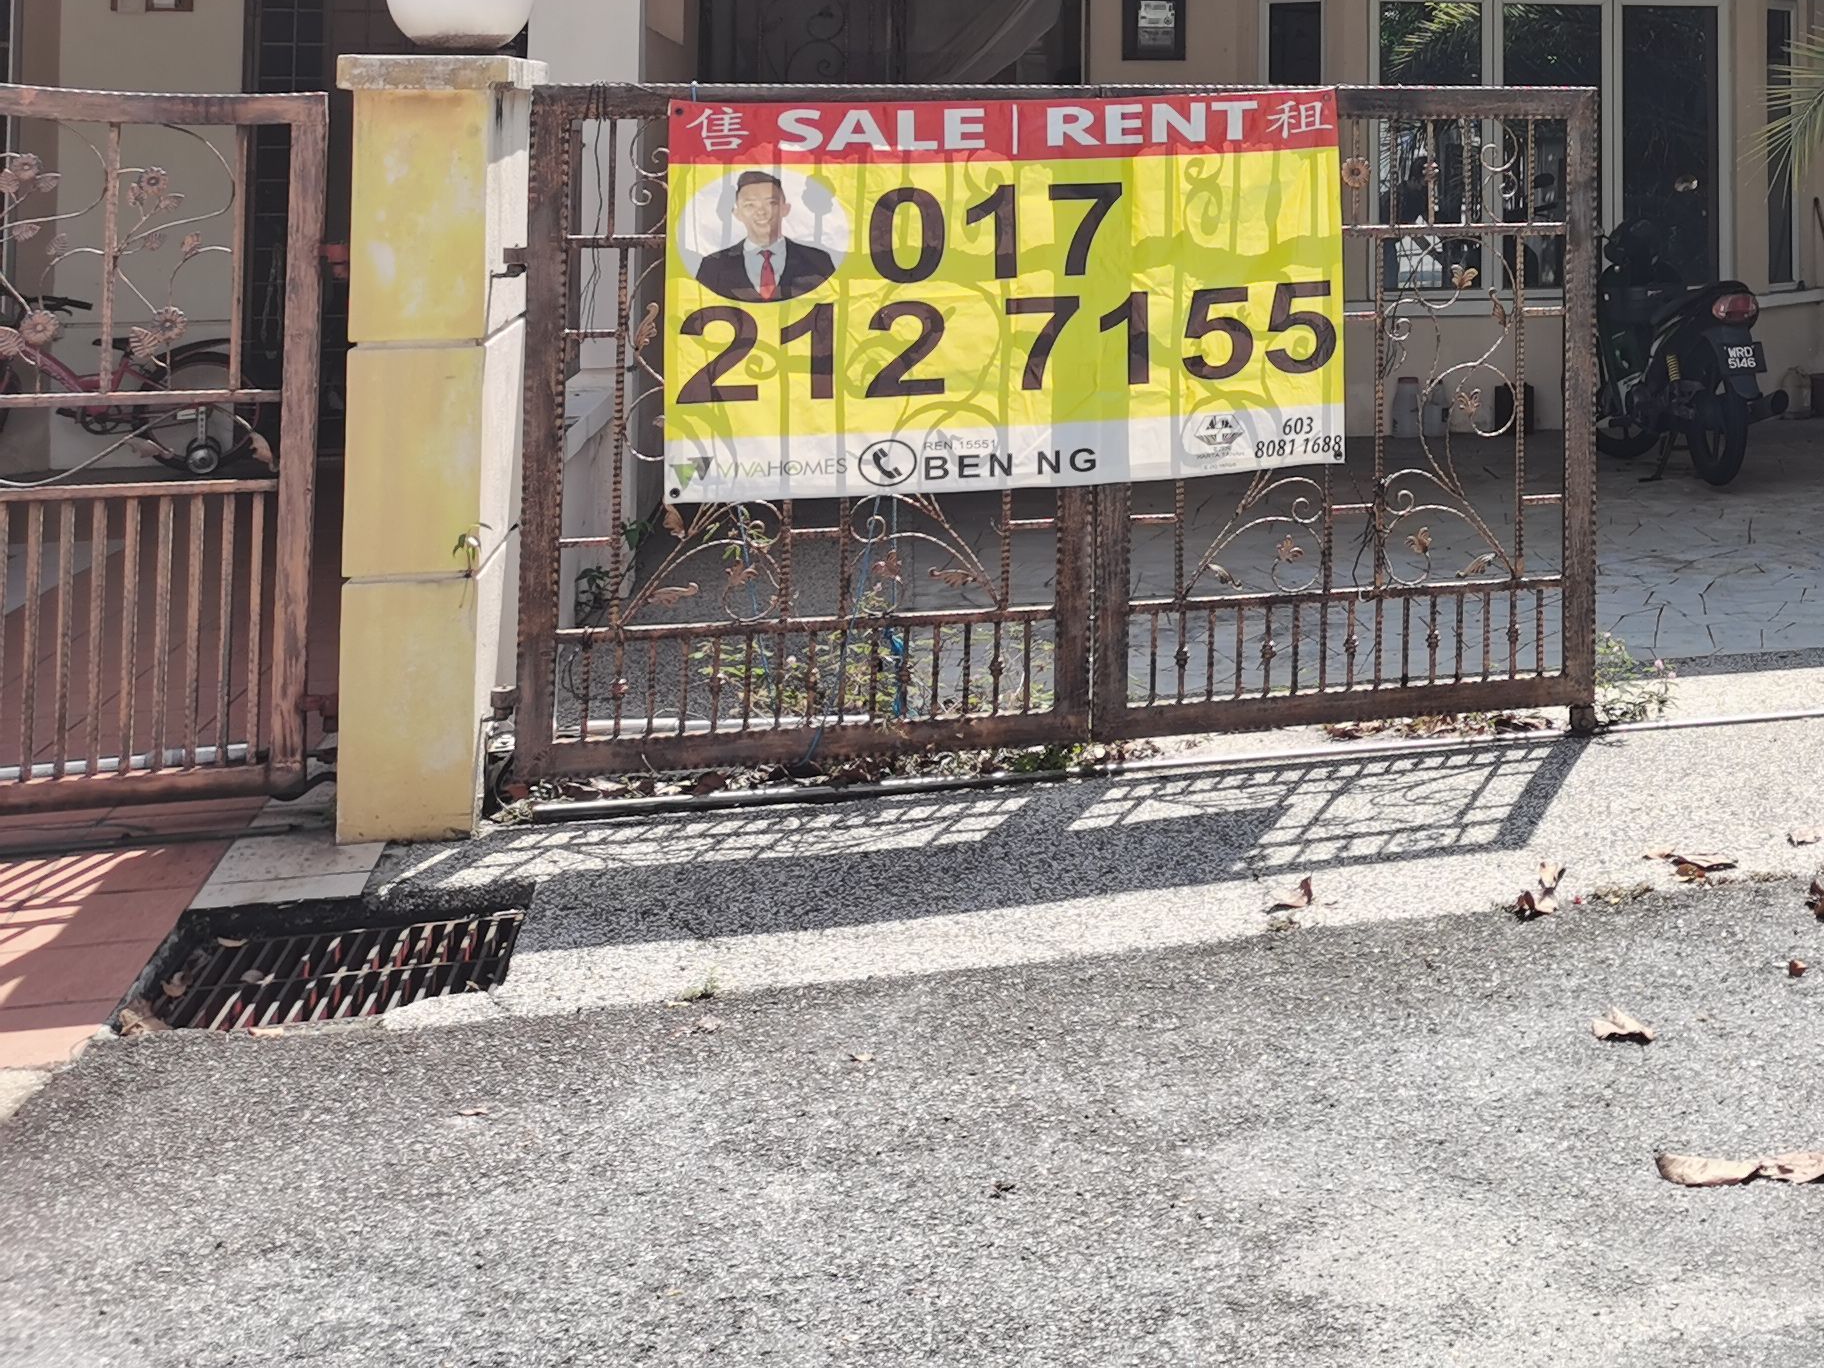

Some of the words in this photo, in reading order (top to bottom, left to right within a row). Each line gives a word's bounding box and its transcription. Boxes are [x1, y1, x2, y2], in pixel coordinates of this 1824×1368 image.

[686, 107, 749, 152] 售
[777, 106, 986, 153] SALE
[1050, 101, 1259, 146] RENT
[1265, 100, 1334, 140] 租
[869, 182, 1123, 284] 017
[676, 301, 945, 405] 212
[1003, 280, 1337, 392] 7155
[1728, 345, 1754, 358] WRD
[1727, 357, 1757, 369] 5146
[1282, 416, 1314, 436] 603
[923, 452, 1014, 481] BEN
[1037, 447, 1098, 476] NG
[1254, 436, 1297, 459] 8081
[1302, 435, 1343, 455] 1688
[714, 457, 848, 478] VIVAHOMES
